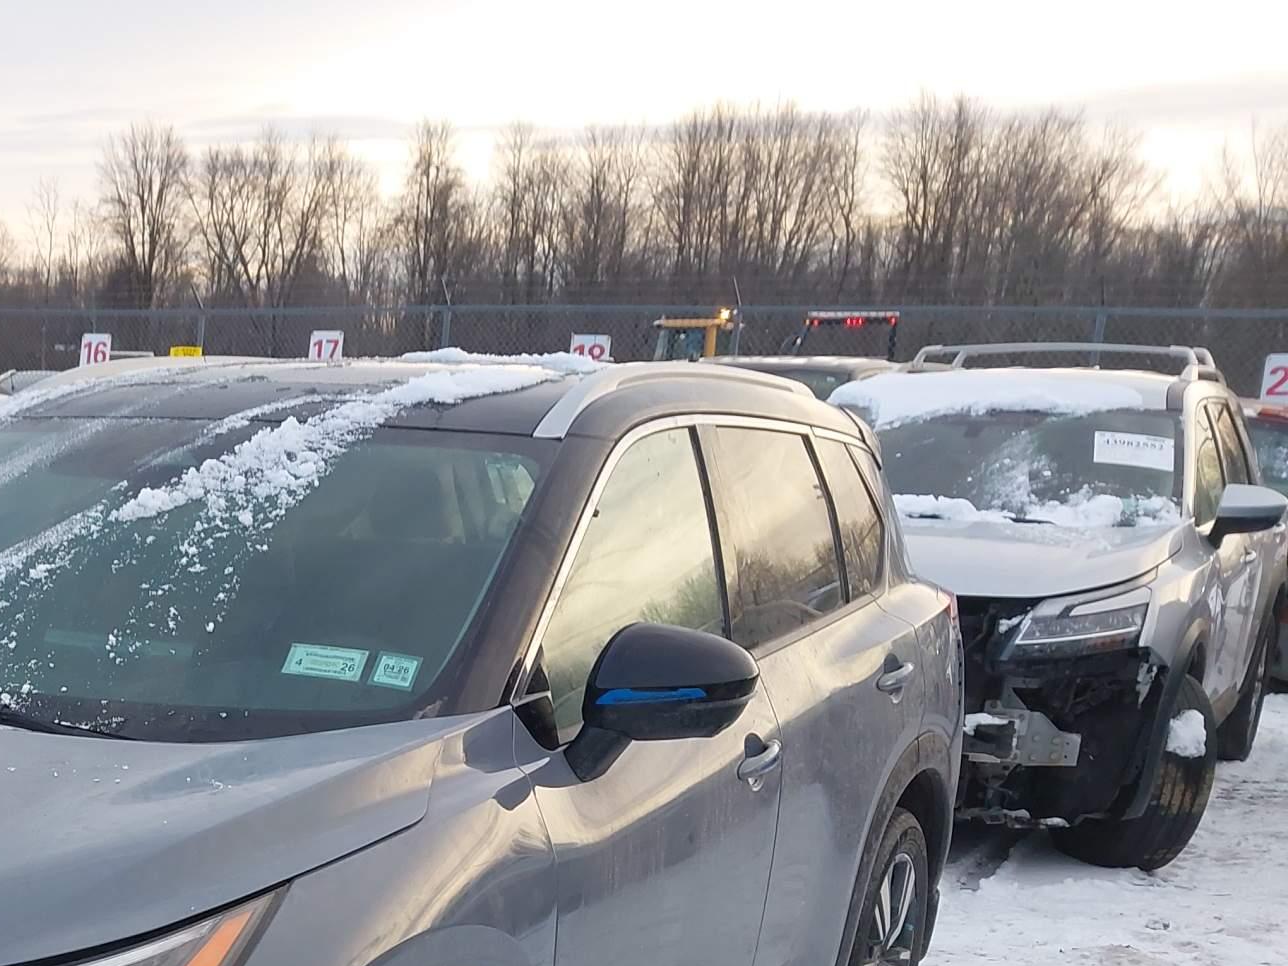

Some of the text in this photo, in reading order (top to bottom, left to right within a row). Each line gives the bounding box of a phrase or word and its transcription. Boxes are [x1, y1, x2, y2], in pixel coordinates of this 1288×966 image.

[83, 341, 108, 365] 16
[313, 339, 340, 360] 17
[339, 661, 357, 674] 26
